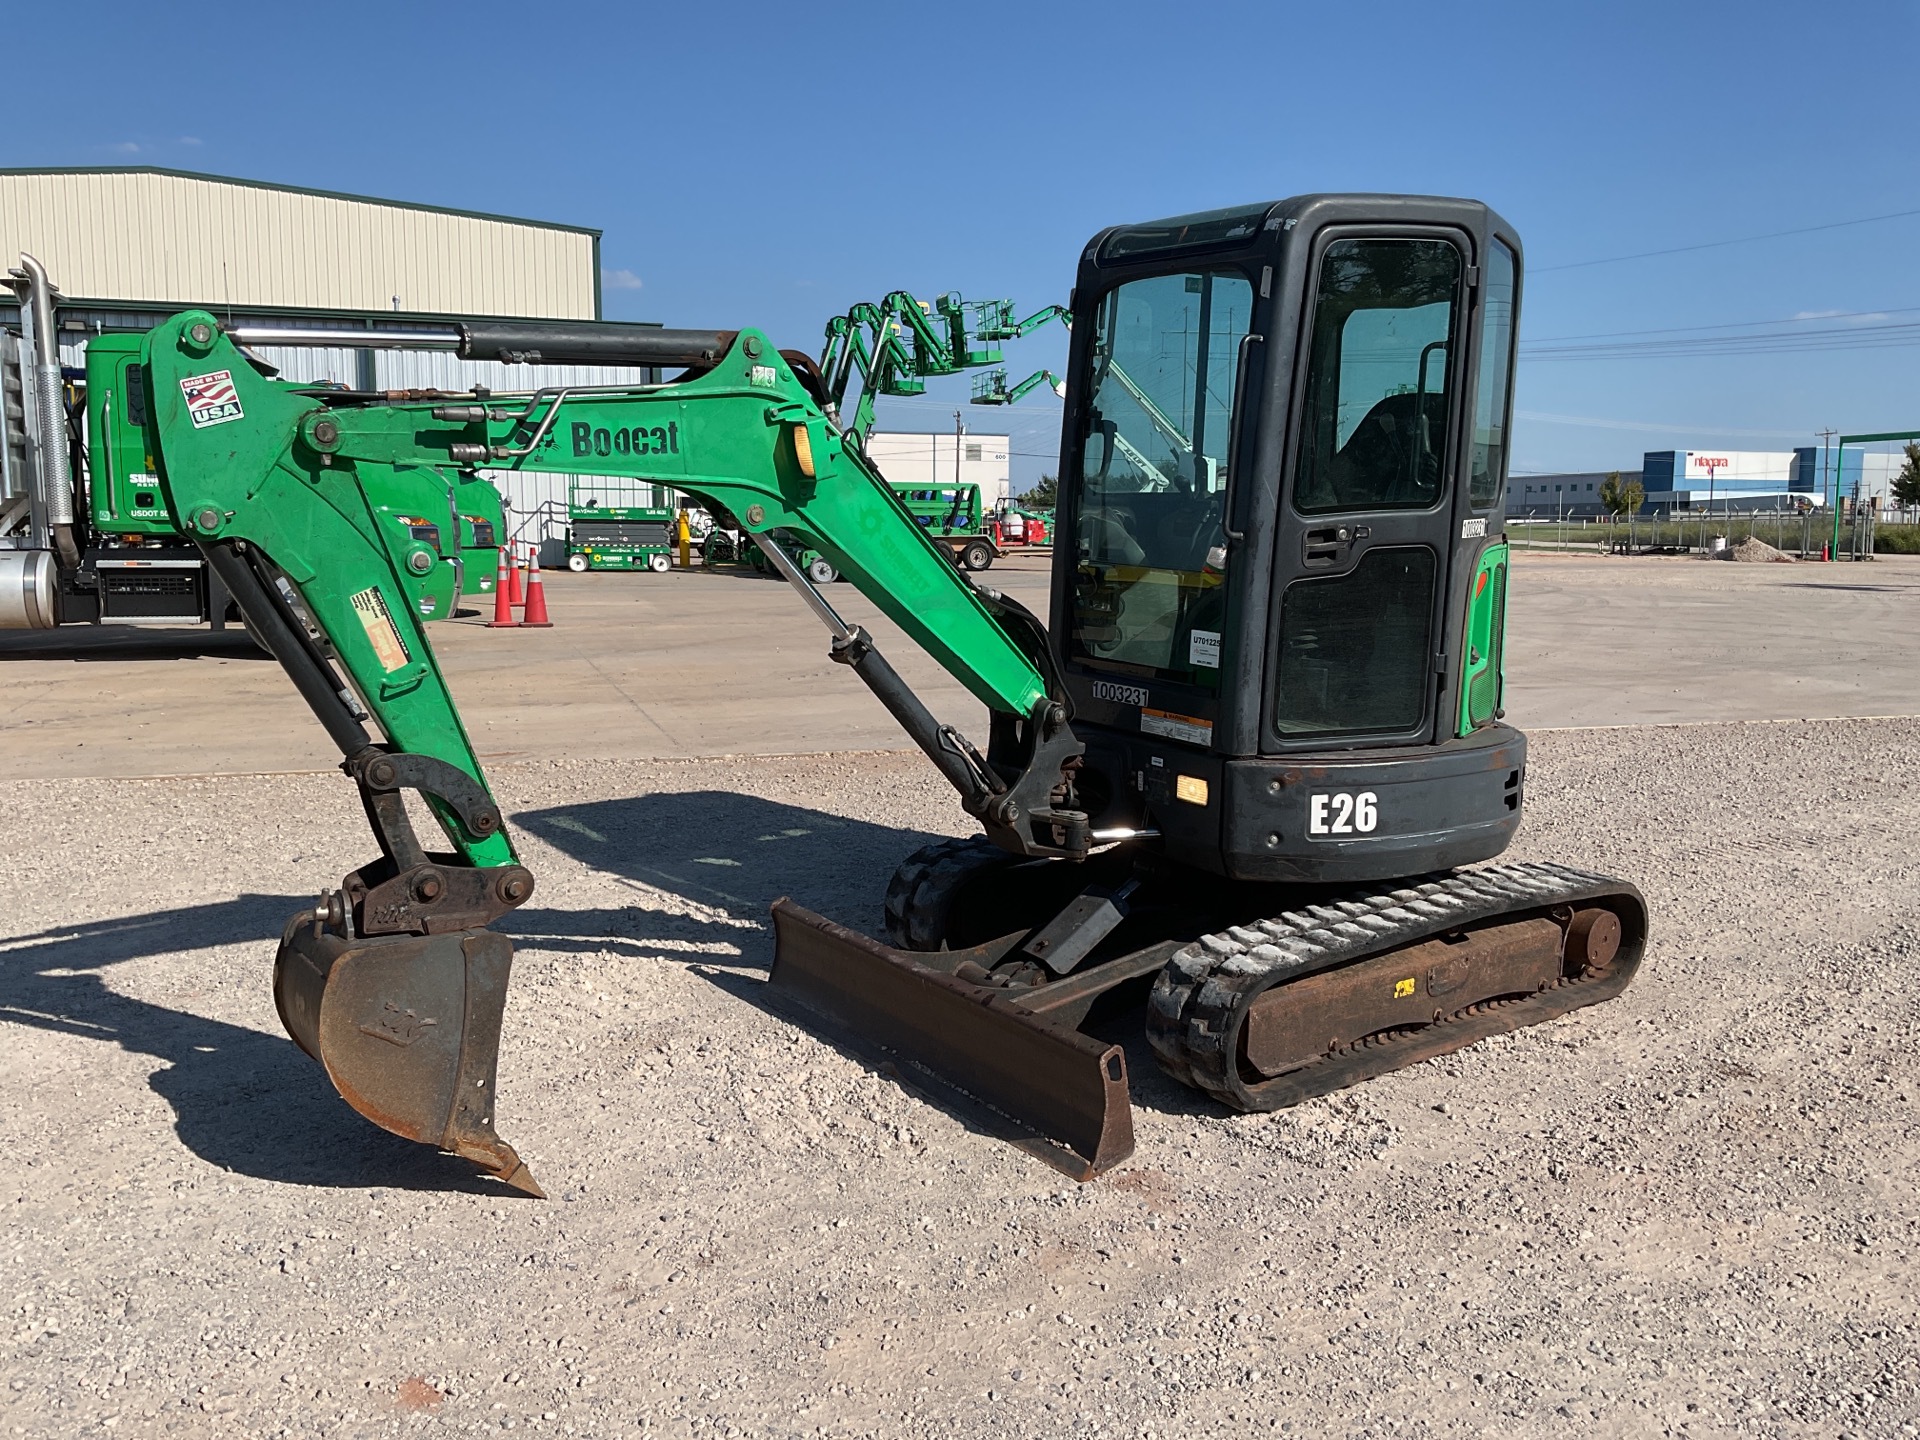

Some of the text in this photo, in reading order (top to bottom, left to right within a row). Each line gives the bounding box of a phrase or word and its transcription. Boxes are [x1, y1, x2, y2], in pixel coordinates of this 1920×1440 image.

[184, 379, 204, 388] MADE
[213, 373, 228, 381] THE
[194, 404, 239, 422] USA
[1193, 636, 1220, 647] U701225
[1092, 681, 1148, 706] 1003231
[1310, 791, 1378, 834] E26
